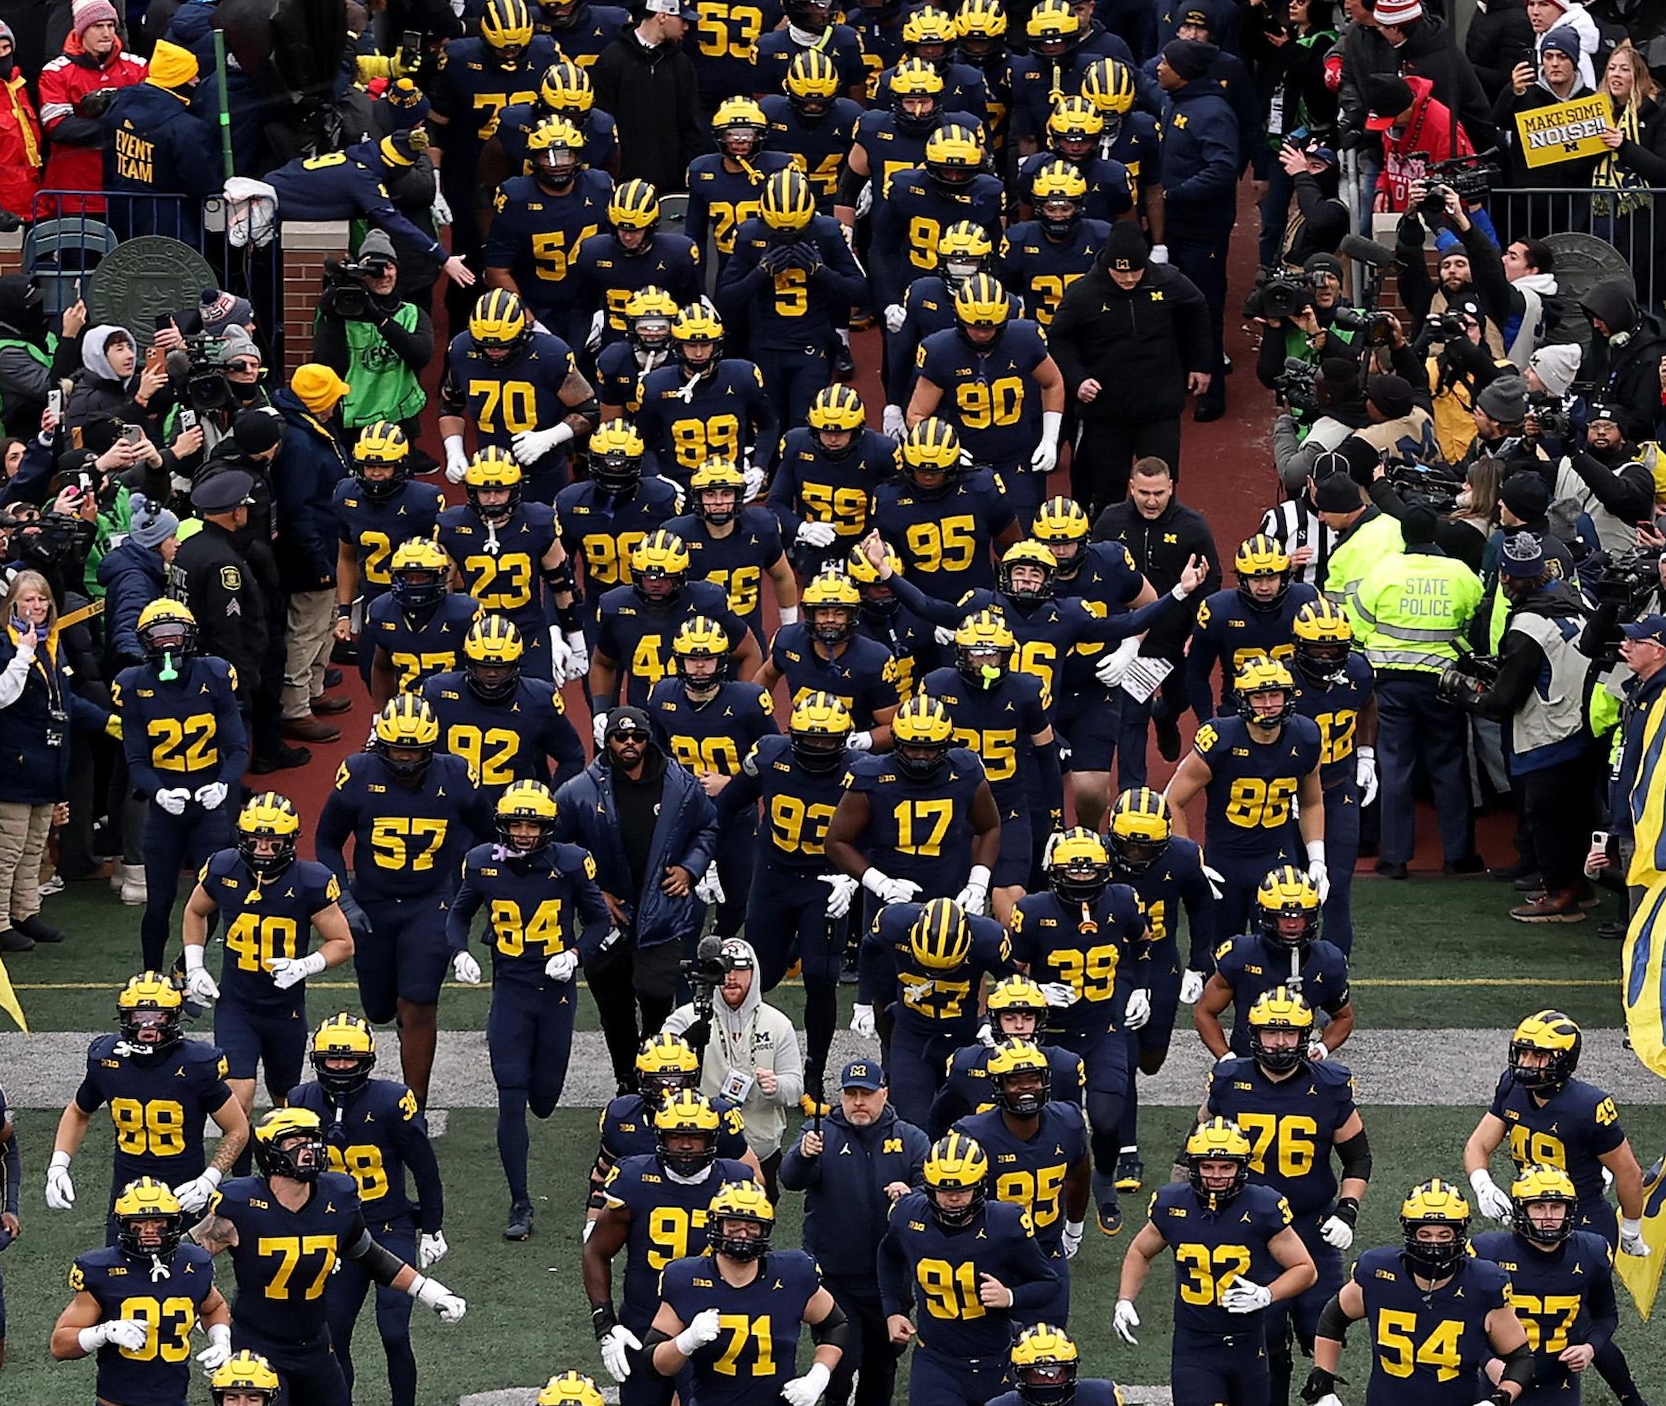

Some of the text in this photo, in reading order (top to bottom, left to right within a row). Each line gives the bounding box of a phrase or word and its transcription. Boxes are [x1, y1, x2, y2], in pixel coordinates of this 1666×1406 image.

[697, 1, 762, 58] 53
[1523, 101, 1604, 133] MAKE SOME
[1528, 118, 1607, 150] NOISE!!
[115, 129, 154, 162] EVENT
[117, 152, 153, 184] TEAM
[1563, 141, 1579, 153] M
[775, 269, 807, 316] 5
[469, 380, 537, 434] 70
[957, 376, 1024, 429] 90
[671, 413, 738, 467] 89
[802, 482, 867, 535] 59
[1297, 529, 1307, 541] S
[906, 515, 975, 572] 95
[1164, 533, 1177, 544] M
[465, 553, 531, 611] 23
[1399, 600, 1452, 617] POLICE
[1405, 579, 1449, 596] STATE
[148, 713, 217, 772] 22
[448, 724, 520, 783] 92
[1197, 727, 1215, 750] 86
[770, 793, 834, 854] 93
[894, 799, 953, 856] 17
[1225, 778, 1295, 828] 86
[371, 817, 448, 871] 57
[226, 913, 296, 972] 40
[491, 899, 564, 956] 84
[898, 972, 970, 1018] 27
[1048, 944, 1119, 1002] 39
[850, 1065, 866, 1076] M
[111, 1097, 185, 1156] 88
[399, 1089, 417, 1120] 38
[1596, 1095, 1619, 1125] 49
[882, 1138, 903, 1154] M
[1235, 1113, 1317, 1177] 76
[1510, 1125, 1566, 1171] 49
[258, 1235, 337, 1300] 77
[917, 1258, 985, 1319] 91
[1176, 1243, 1251, 1305] 32
[119, 1296, 195, 1362] 83
[714, 1315, 775, 1376] 71
[1378, 1308, 1464, 1382] 54
